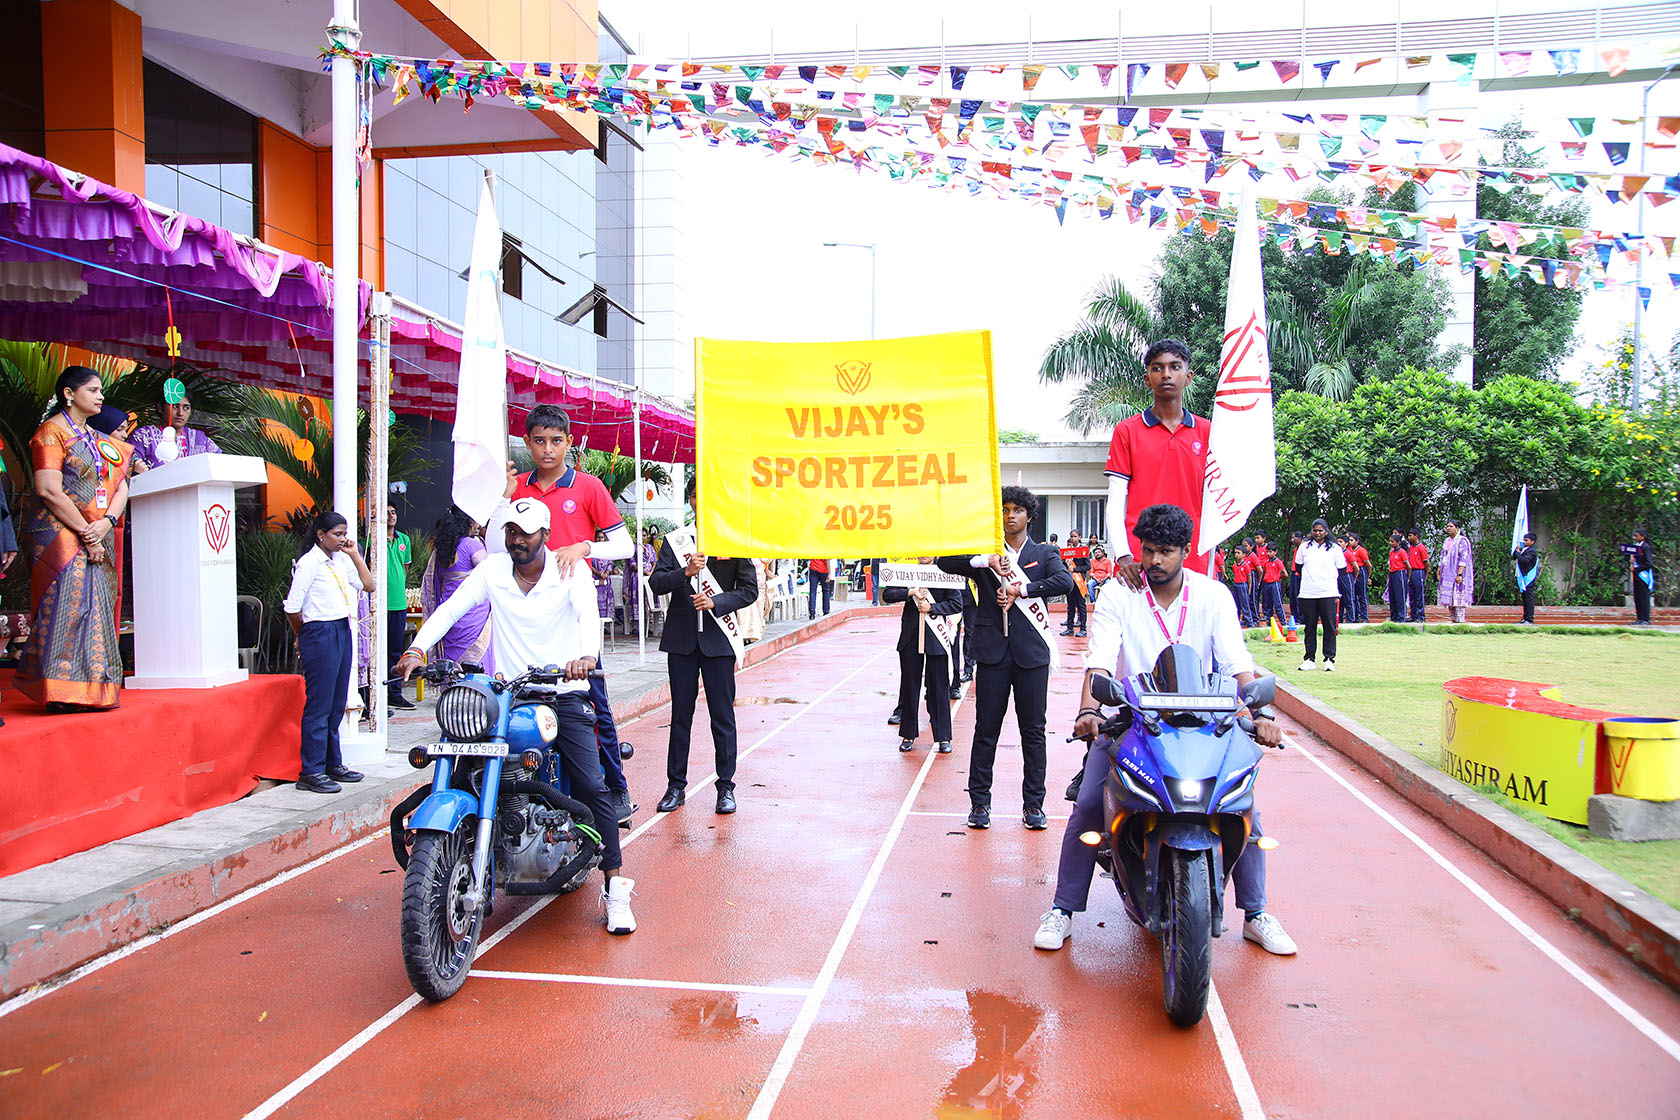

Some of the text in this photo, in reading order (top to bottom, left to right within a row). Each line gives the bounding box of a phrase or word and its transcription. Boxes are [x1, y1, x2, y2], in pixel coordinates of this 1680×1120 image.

[785, 403, 925, 439] VIJAY'S
[751, 452, 968, 489] SPORTZEAL
[824, 504, 893, 531] 2025
[895, 570, 915, 581] VIJAY
[722, 613, 738, 638] BOY
[1028, 602, 1049, 631] BOY
[433, 744, 444, 753] TN
[481, 744, 506, 755] 9028
[1137, 769, 1156, 785] MAN
